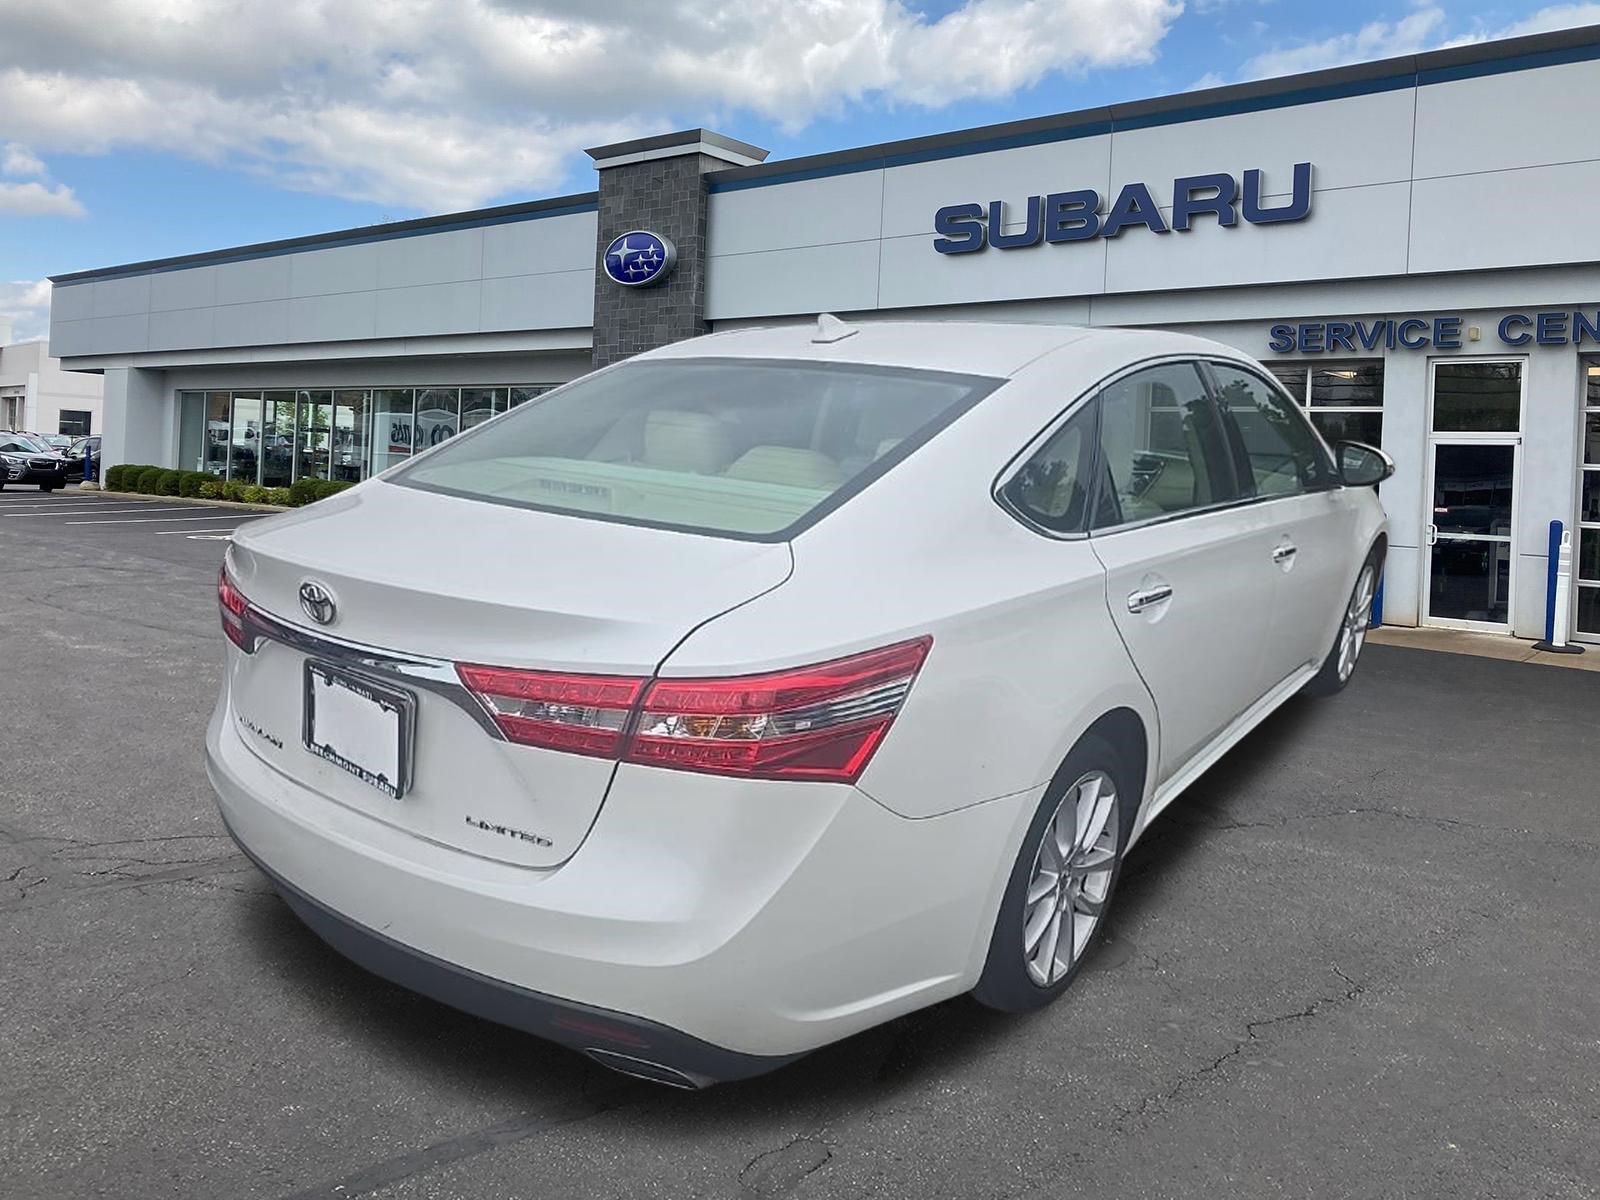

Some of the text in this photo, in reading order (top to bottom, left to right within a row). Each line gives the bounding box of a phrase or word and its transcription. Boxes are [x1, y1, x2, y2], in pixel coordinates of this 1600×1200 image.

[933, 162, 1313, 255] SUBARU
[1268, 317, 1463, 353] SERVICE
[362, 770, 397, 799] SUBARU
[465, 815, 553, 847] LIMITED
